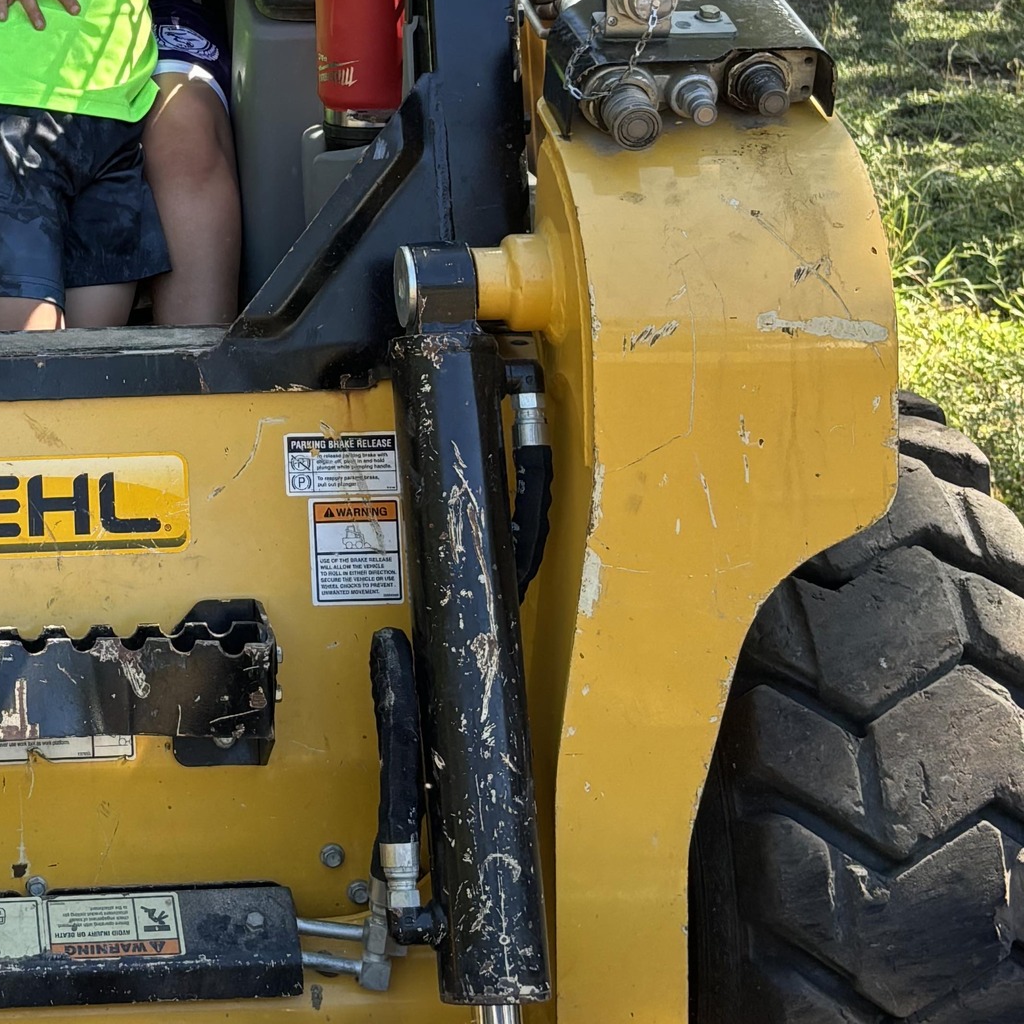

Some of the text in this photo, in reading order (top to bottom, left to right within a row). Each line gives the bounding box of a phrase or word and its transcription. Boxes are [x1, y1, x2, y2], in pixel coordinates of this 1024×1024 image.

[290, 438, 392, 450] PARKING BRAKE RELEASE
[64, 942, 146, 955] WARNING
